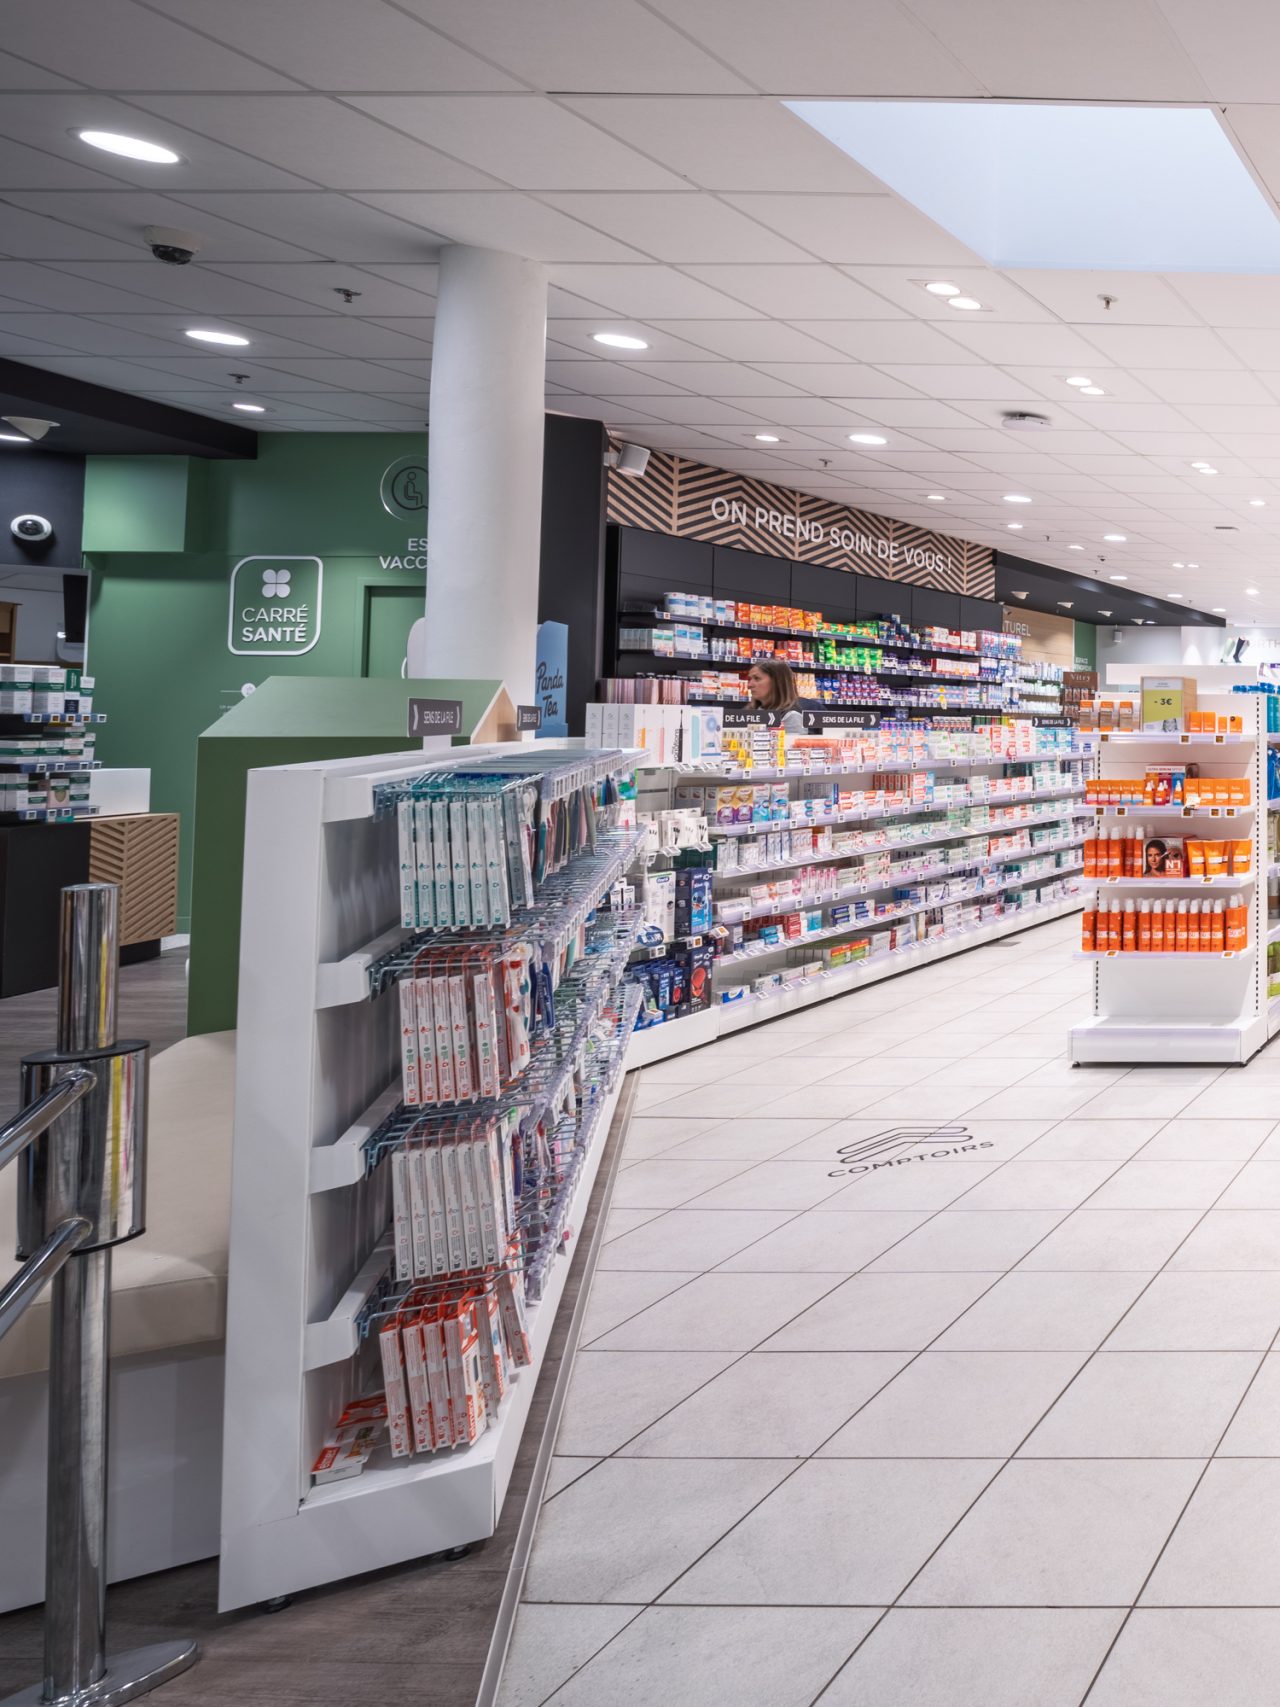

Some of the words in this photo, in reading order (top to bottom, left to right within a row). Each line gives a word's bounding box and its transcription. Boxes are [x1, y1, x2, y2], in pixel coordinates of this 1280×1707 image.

[711, 496, 747, 527] ON
[755, 508, 824, 543] PREND
[830, 527, 872, 556] SOIN
[878, 540, 899, 562] DE
[904, 547, 944, 573] VOUS
[408, 538, 428, 551] ES
[379, 556, 428, 570] VACC
[241, 604, 309, 623] CARRÉ
[241, 624, 307, 643] SANTÉ
[1002, 620, 1031, 637] TUREL
[536, 661, 564, 694] Panda
[1070, 673, 1090, 682] Vitry
[543, 695, 558, 718] Tea
[822, 716, 836, 724] SENS
[853, 716, 865, 724] FILE
[827, 1141, 995, 1178] COMPTOIRS
